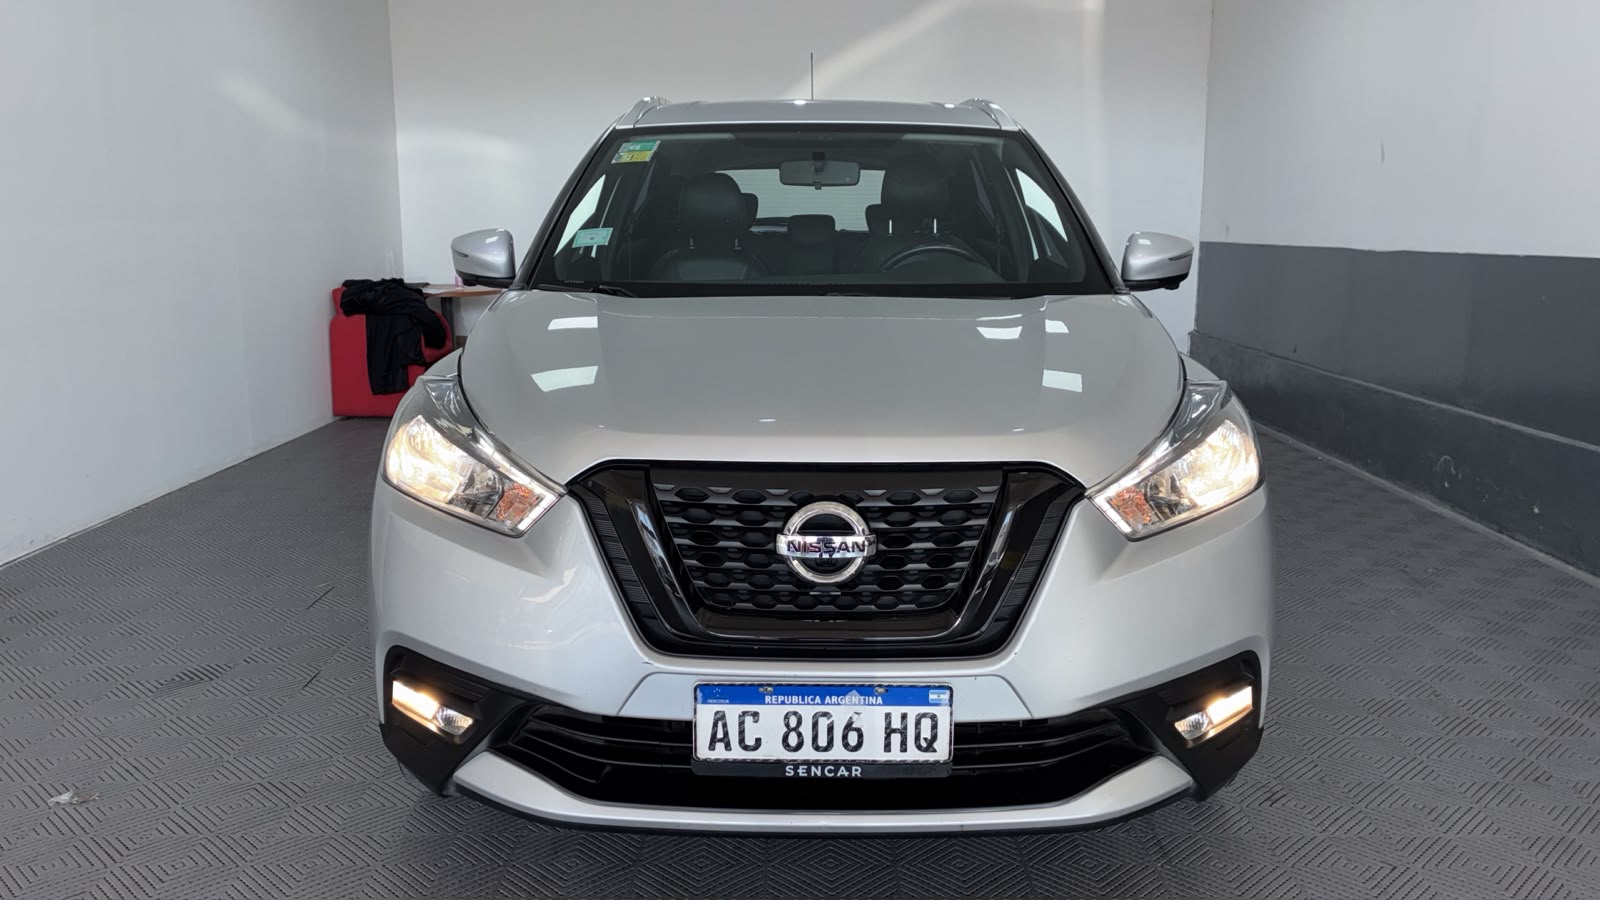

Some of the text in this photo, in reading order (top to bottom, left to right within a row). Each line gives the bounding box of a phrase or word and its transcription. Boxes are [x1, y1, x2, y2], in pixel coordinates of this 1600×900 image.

[787, 540, 865, 553] NISSAN
[765, 695, 883, 705] REPUBLICA ARGENTINA
[708, 710, 939, 753] AC 806 HQ
[785, 765, 862, 778] SENCAR
